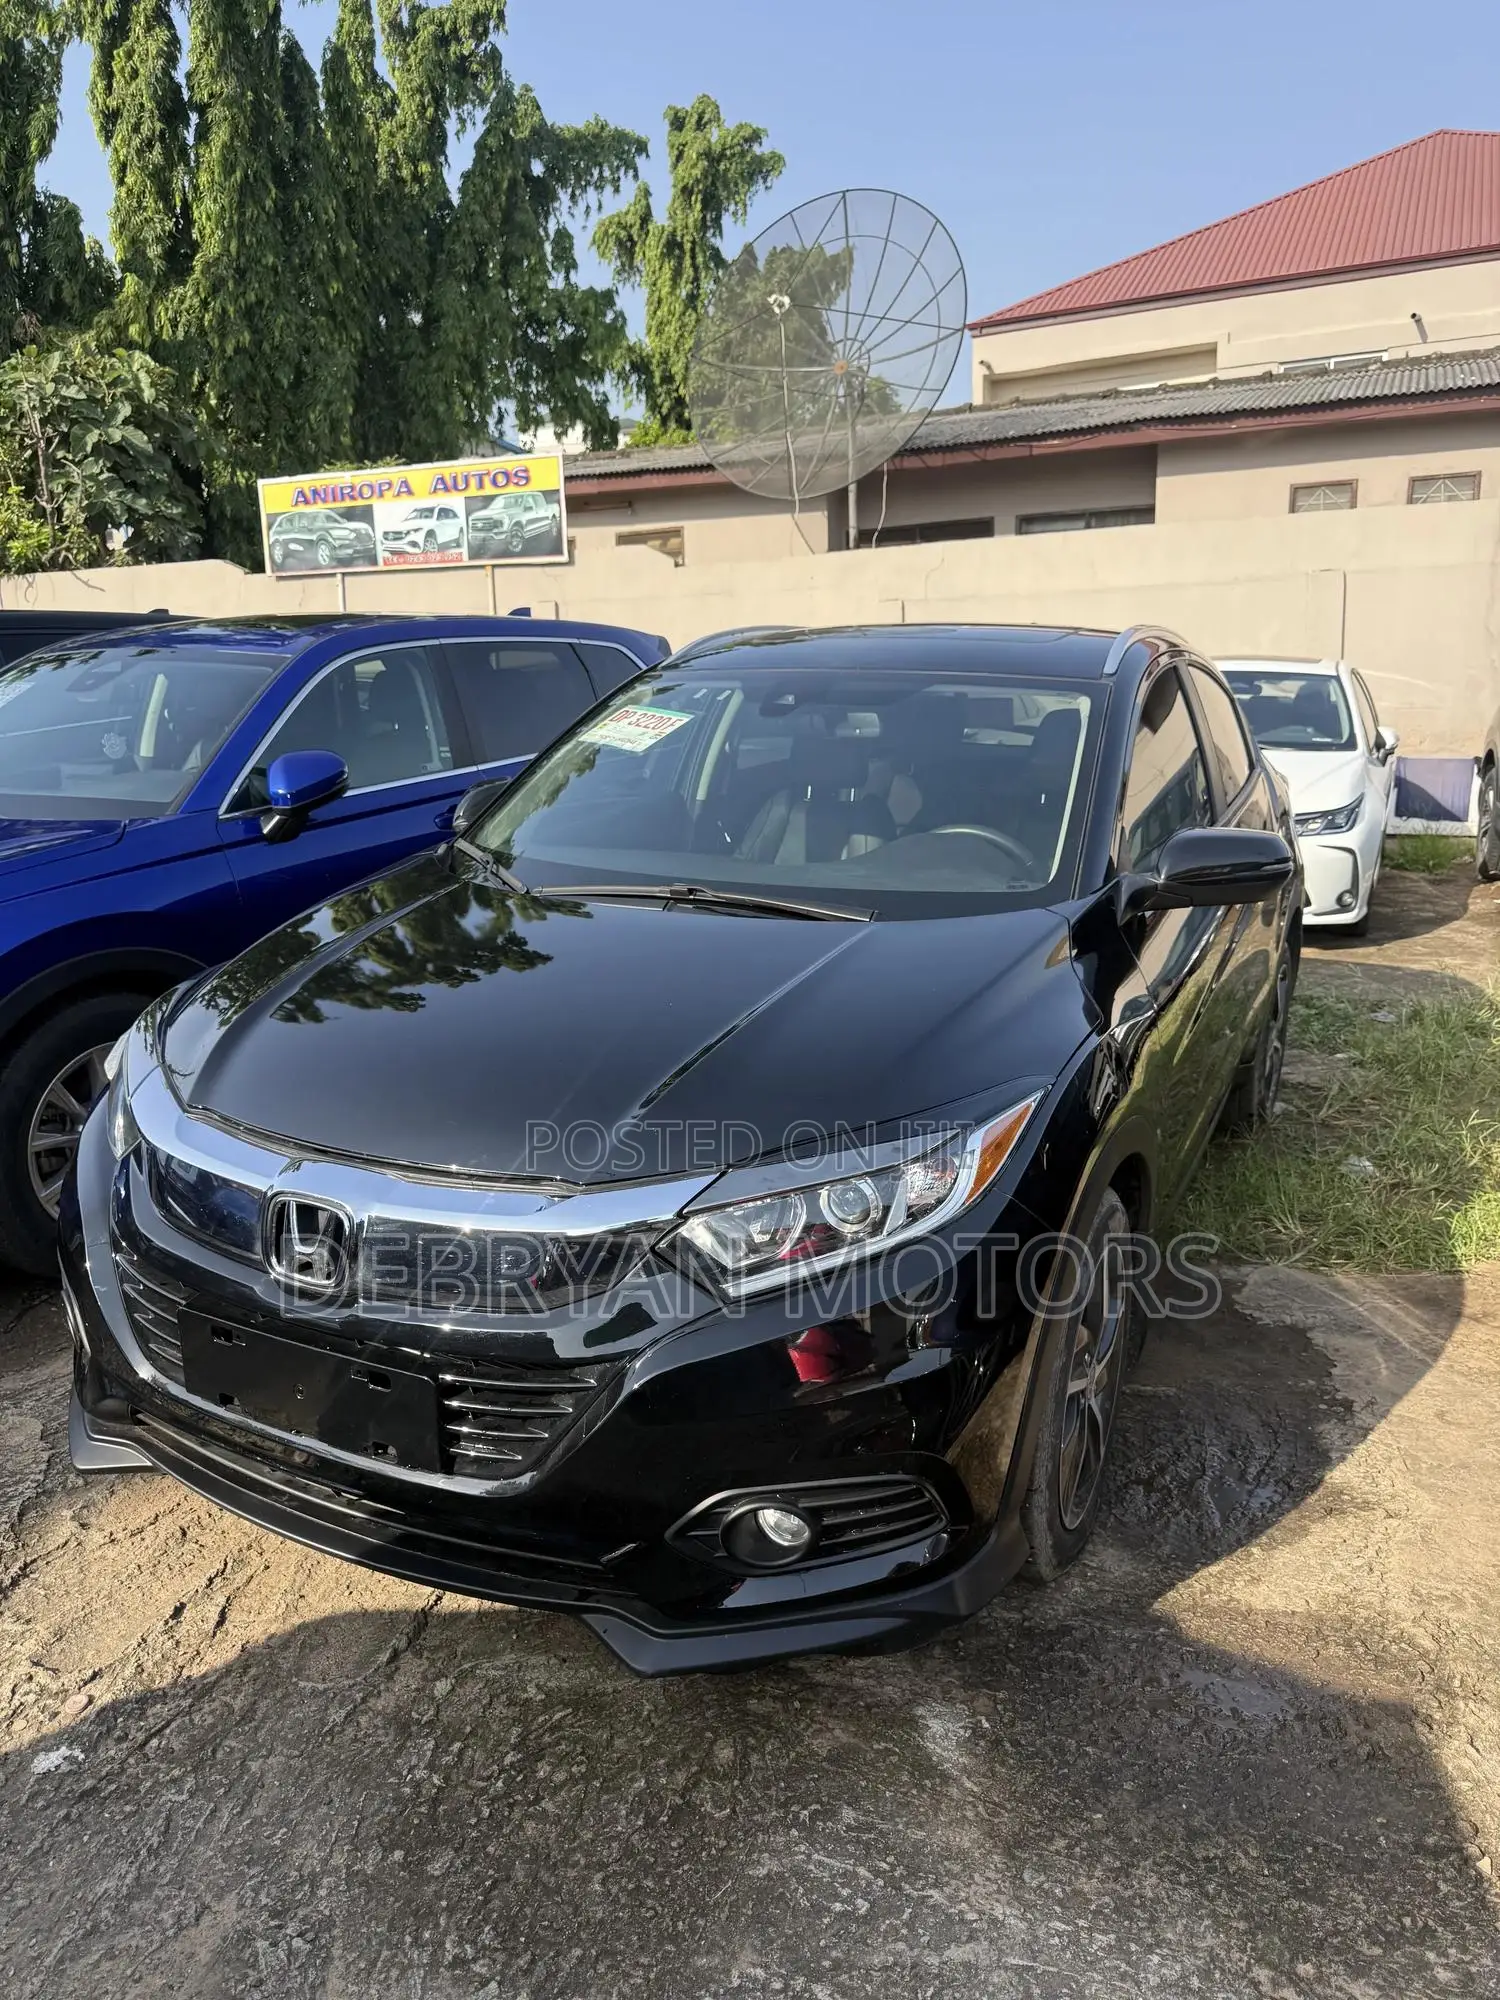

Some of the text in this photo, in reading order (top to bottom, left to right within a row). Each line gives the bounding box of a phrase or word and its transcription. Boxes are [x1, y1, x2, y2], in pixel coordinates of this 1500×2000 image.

[291, 465, 531, 507] ANIROPA AUTOS
[627, 713, 671, 731] 3220
